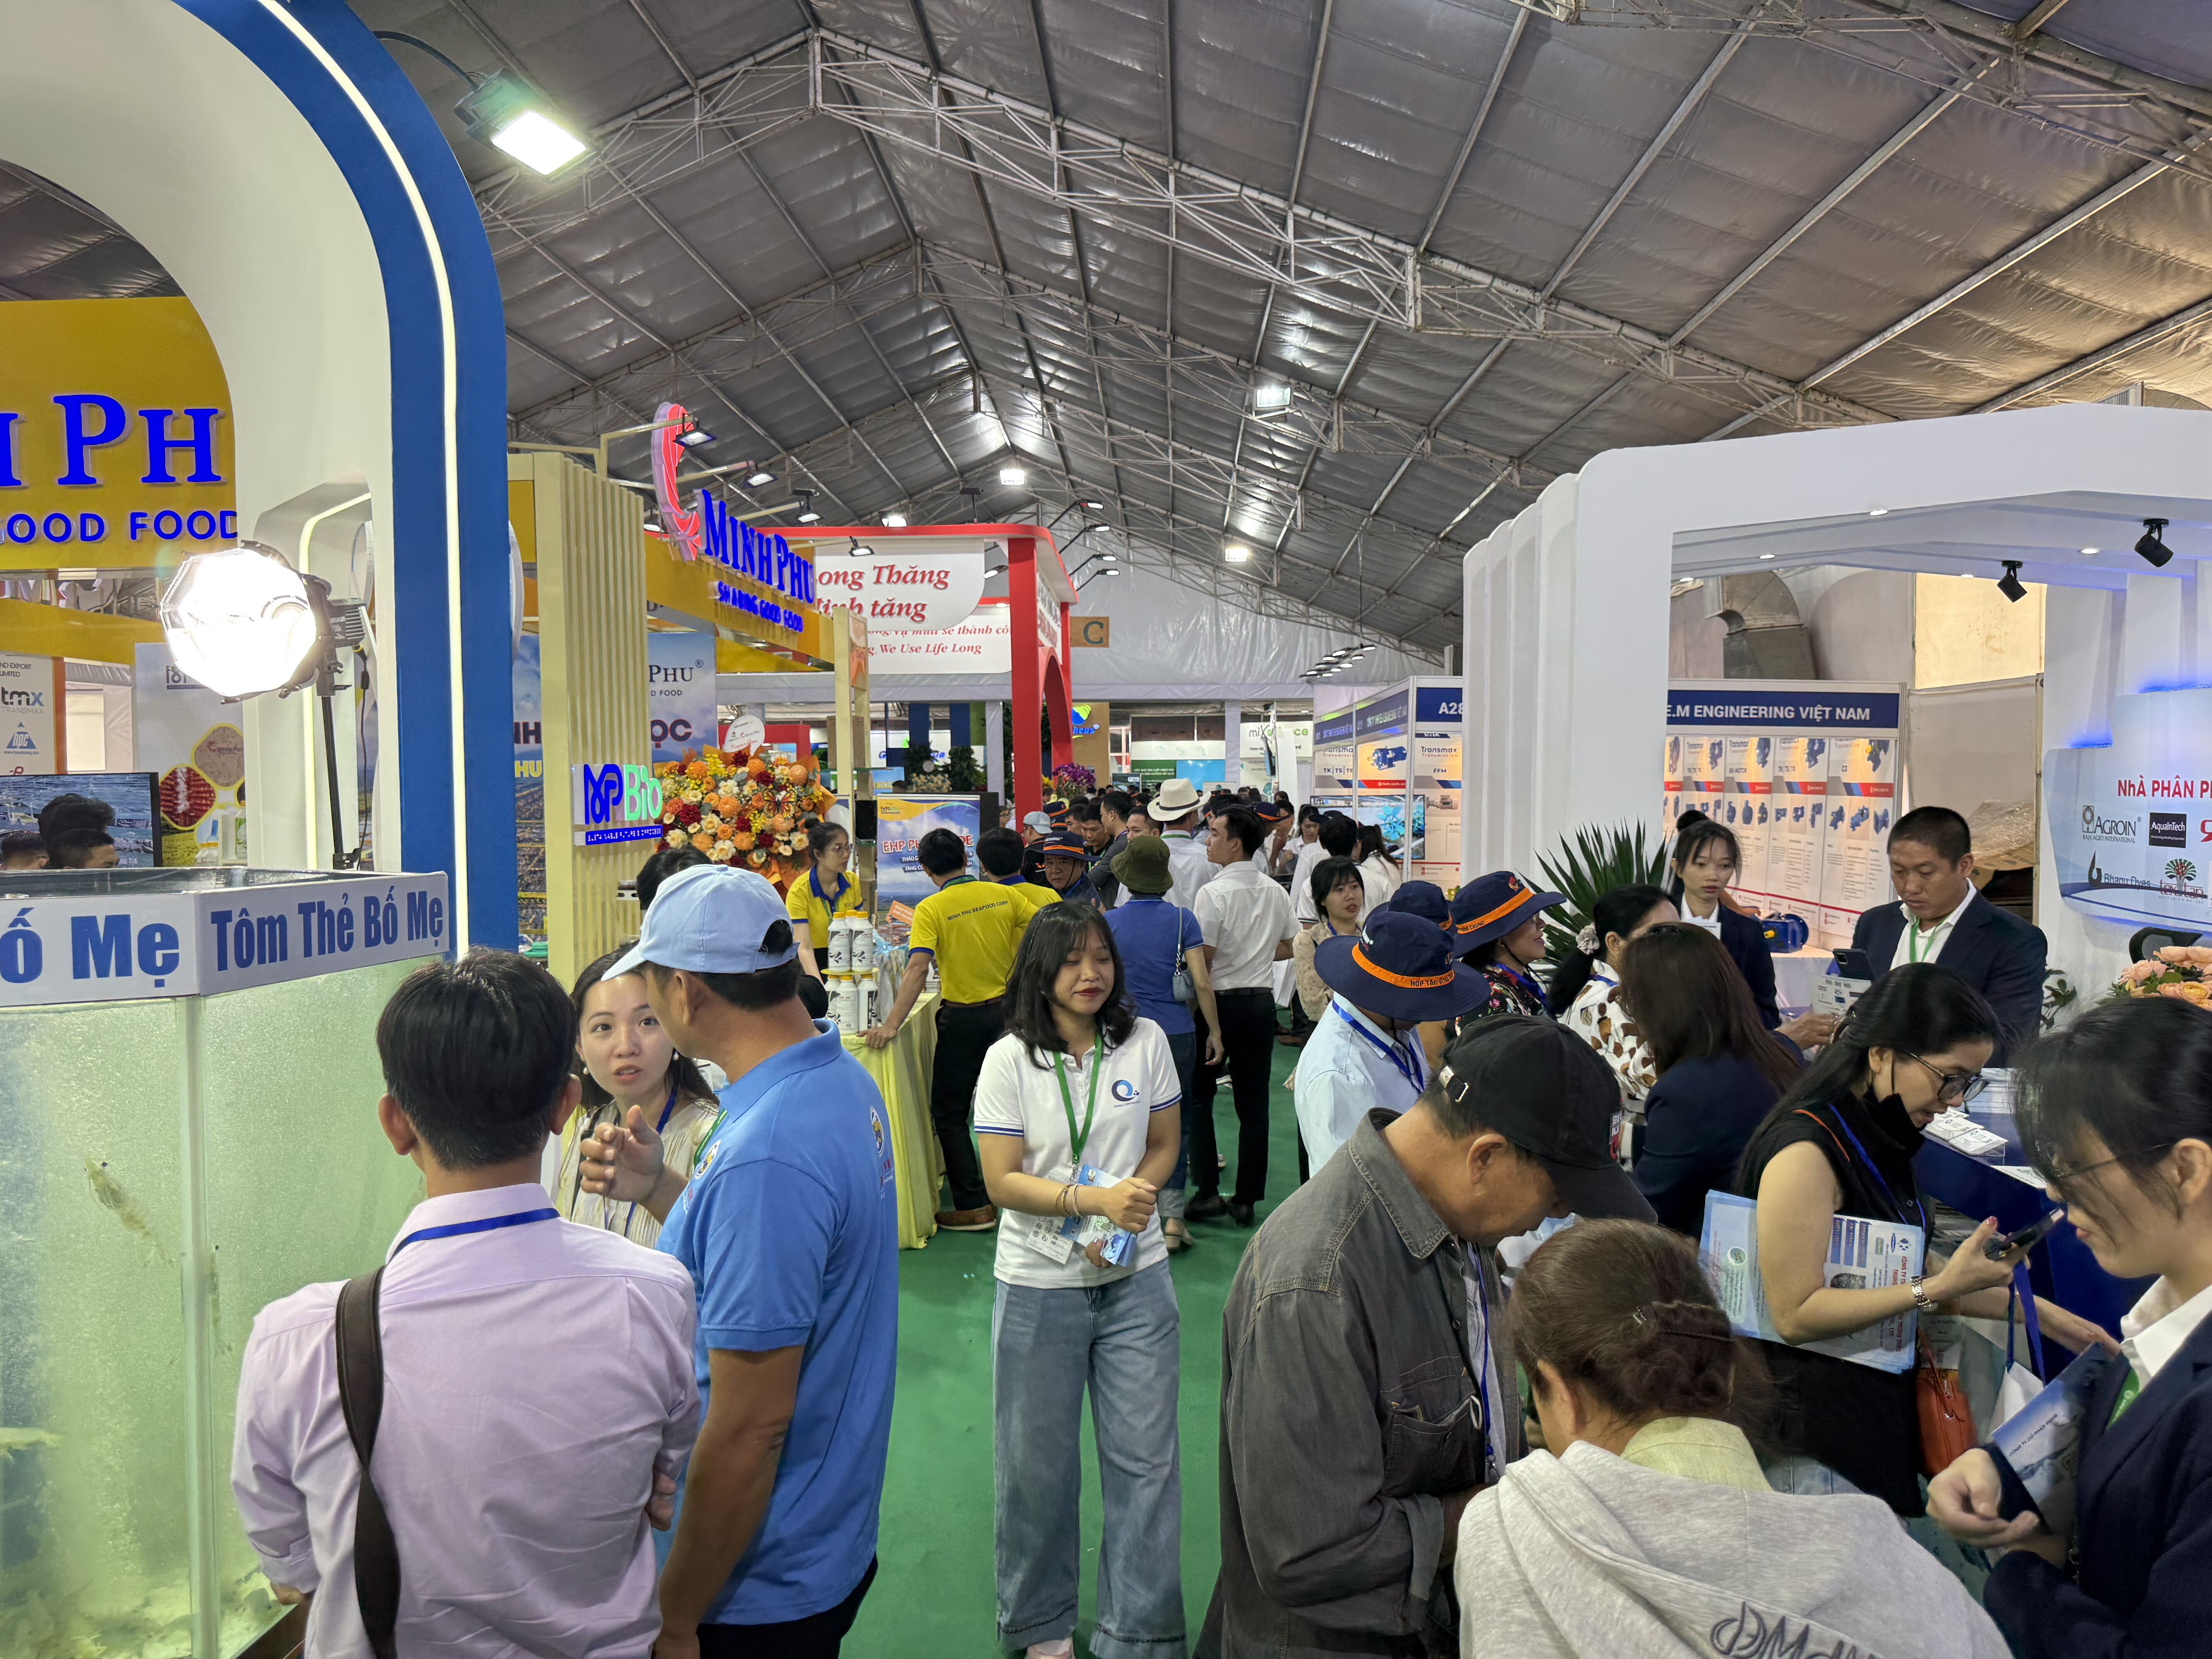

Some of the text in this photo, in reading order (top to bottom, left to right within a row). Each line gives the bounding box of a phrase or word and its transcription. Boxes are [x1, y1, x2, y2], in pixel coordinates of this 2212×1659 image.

[5, 513, 105, 543] OOD
[702, 489, 814, 604] MINH PHU
[818, 564, 950, 591] ong Thăng
[871, 598, 927, 622] tăng
[958, 625, 992, 635] thành
[1083, 621, 1103, 645] C
[880, 644, 896, 654] We
[901, 644, 922, 654] Use
[925, 643, 948, 655] Life
[952, 644, 982, 655] Long
[649, 665, 694, 683] PHU
[2, 687, 44, 706] tmx
[1694, 706, 1795, 720] ENGINEERING
[1799, 704, 1831, 722] VIỆT
[1835, 708, 1870, 720] NAM
[2151, 775, 2194, 798] PHÂN
[2094, 816, 2136, 836] AGROIN
[883, 840, 905, 853] EHP
[947, 913, 961, 921] MINH
[972, 902, 996, 913] SEAFOOD
[211, 885, 443, 971] Tôm Thẻ Bố Mẹ
[0, 907, 180, 988] ố Mẹ
